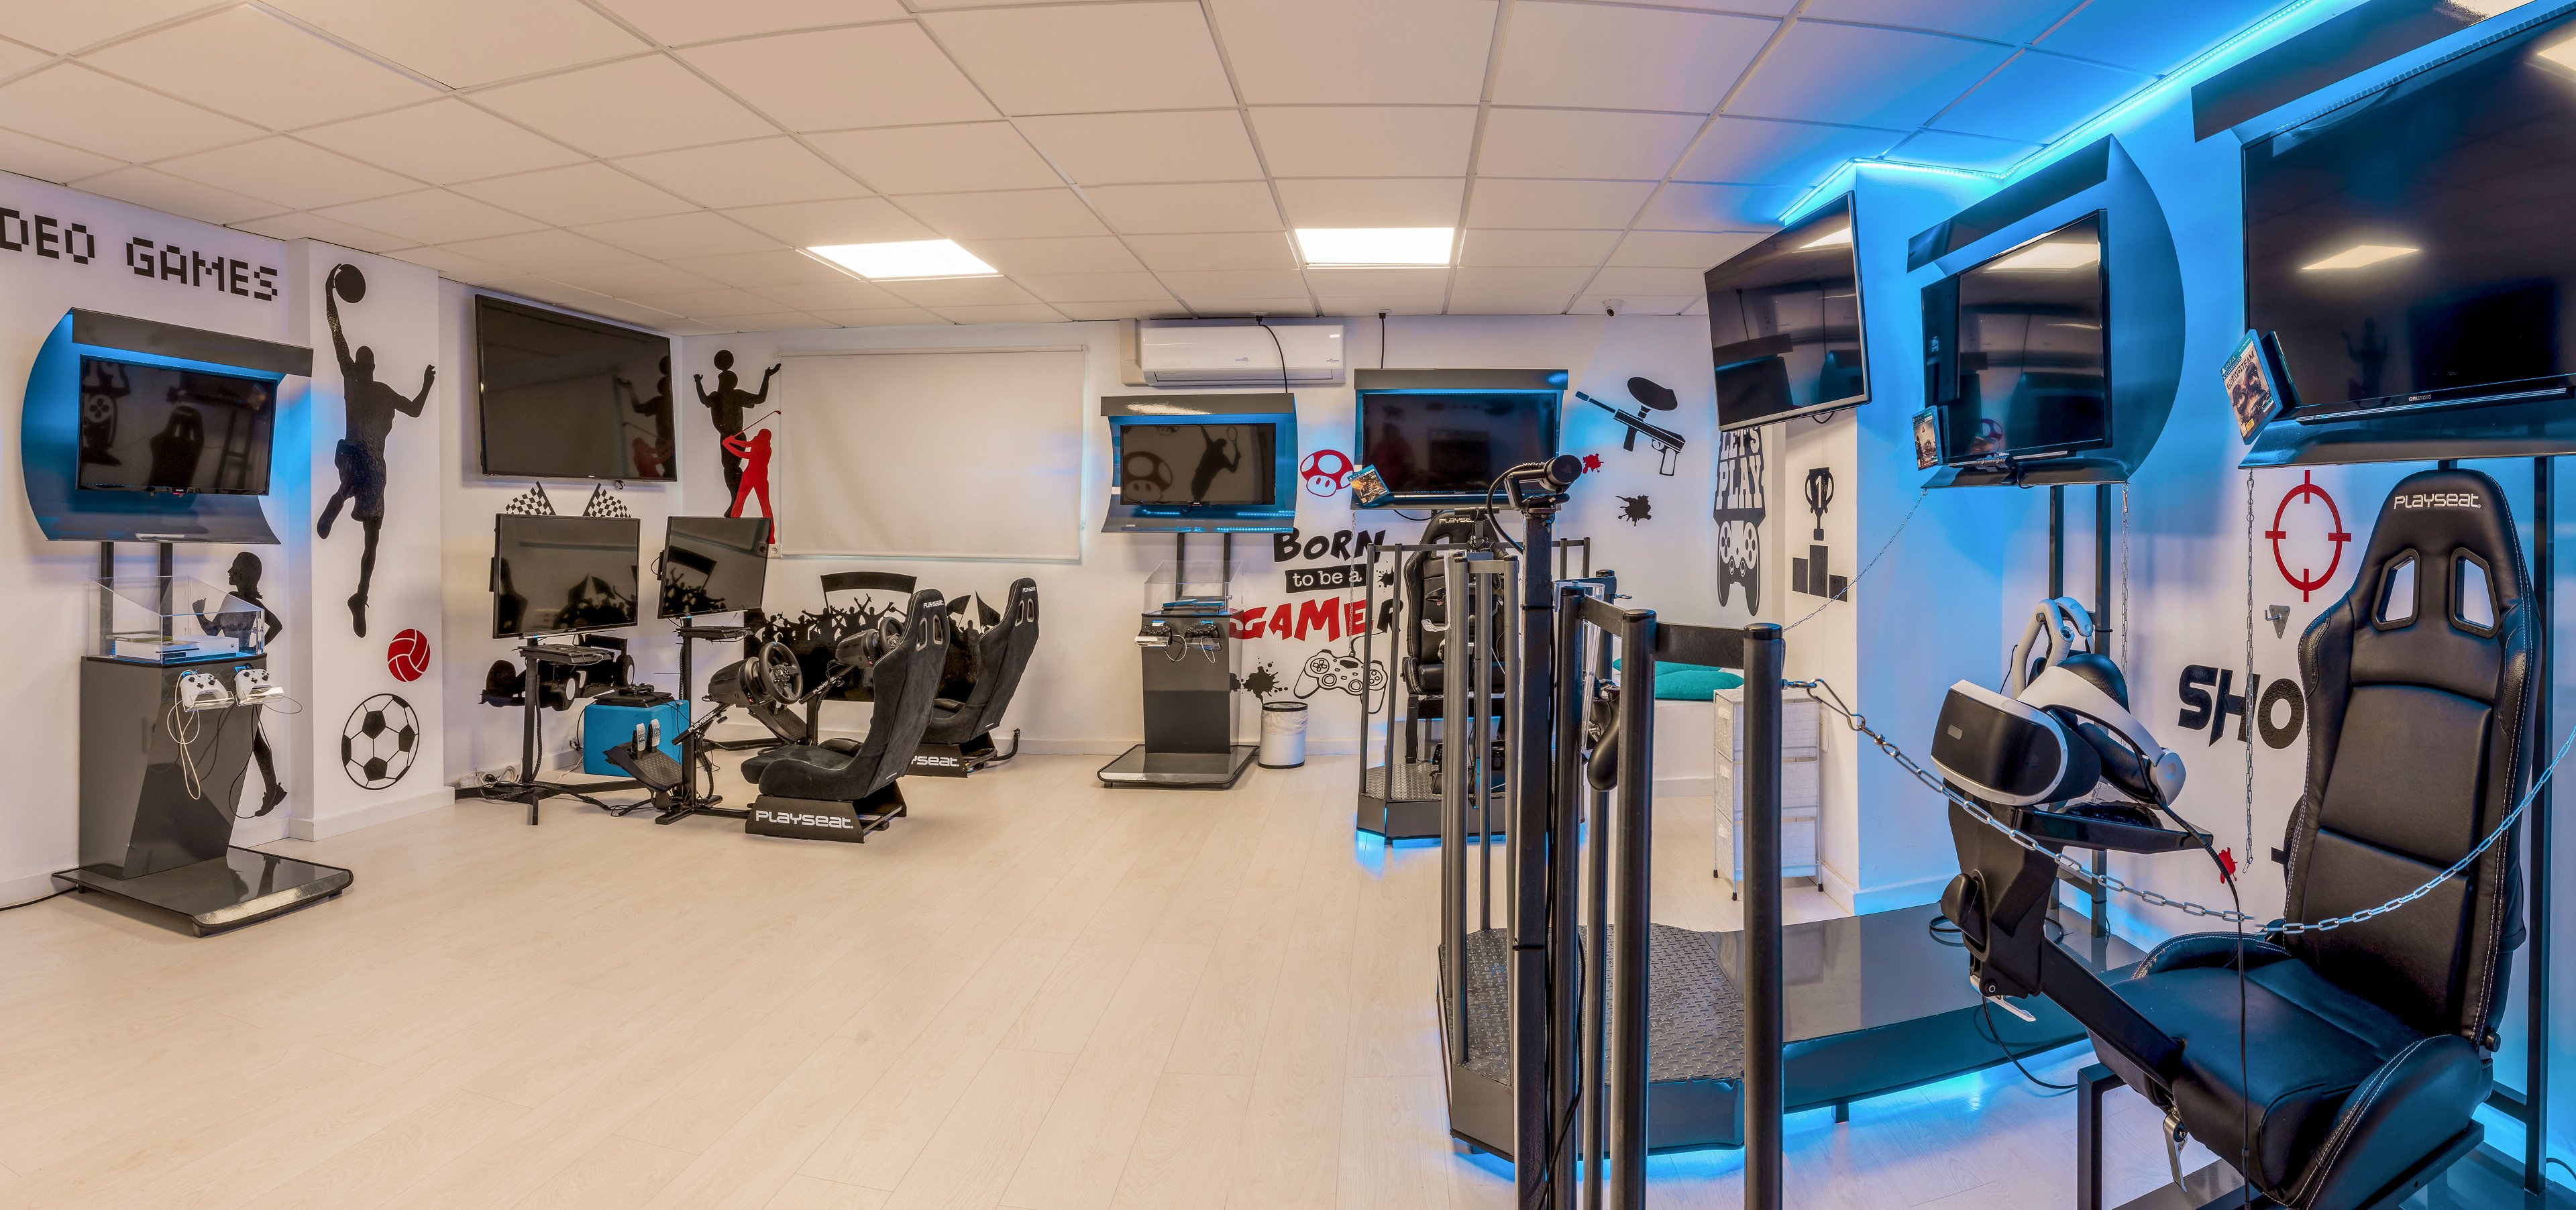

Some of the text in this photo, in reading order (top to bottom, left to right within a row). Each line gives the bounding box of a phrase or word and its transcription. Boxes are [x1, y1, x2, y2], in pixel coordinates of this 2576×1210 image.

[126, 237, 278, 301] GAMES
[2225, 355, 2236, 370] PS4
[2241, 351, 2255, 370] TEAM
[1720, 427, 1761, 460] LET'S
[1715, 454, 1763, 510] PLAY
[1815, 476, 1822, 508] 1
[1274, 527, 1386, 563] BORN
[1292, 570, 1362, 587] to be a
